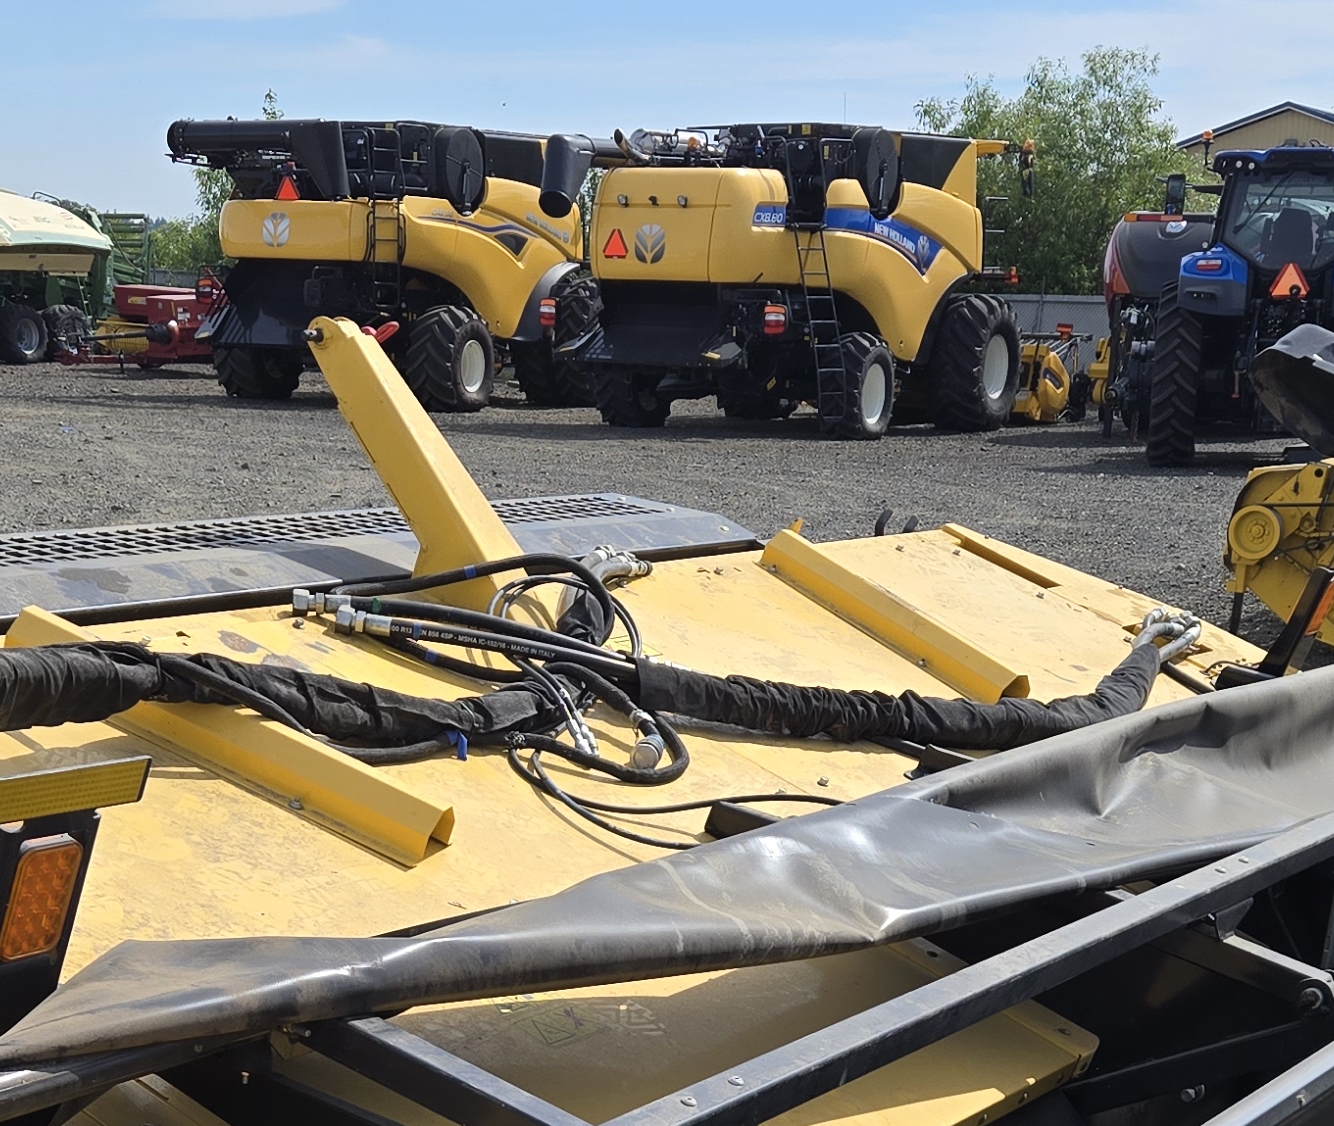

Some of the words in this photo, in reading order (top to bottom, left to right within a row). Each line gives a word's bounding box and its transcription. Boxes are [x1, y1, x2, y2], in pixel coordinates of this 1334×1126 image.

[874, 222, 889, 237] NEW
[889, 227, 916, 254] HOLLAND
[400, 626, 413, 634] R13
[510, 644, 530, 654] MADE
[537, 649, 556, 658] ITALY
